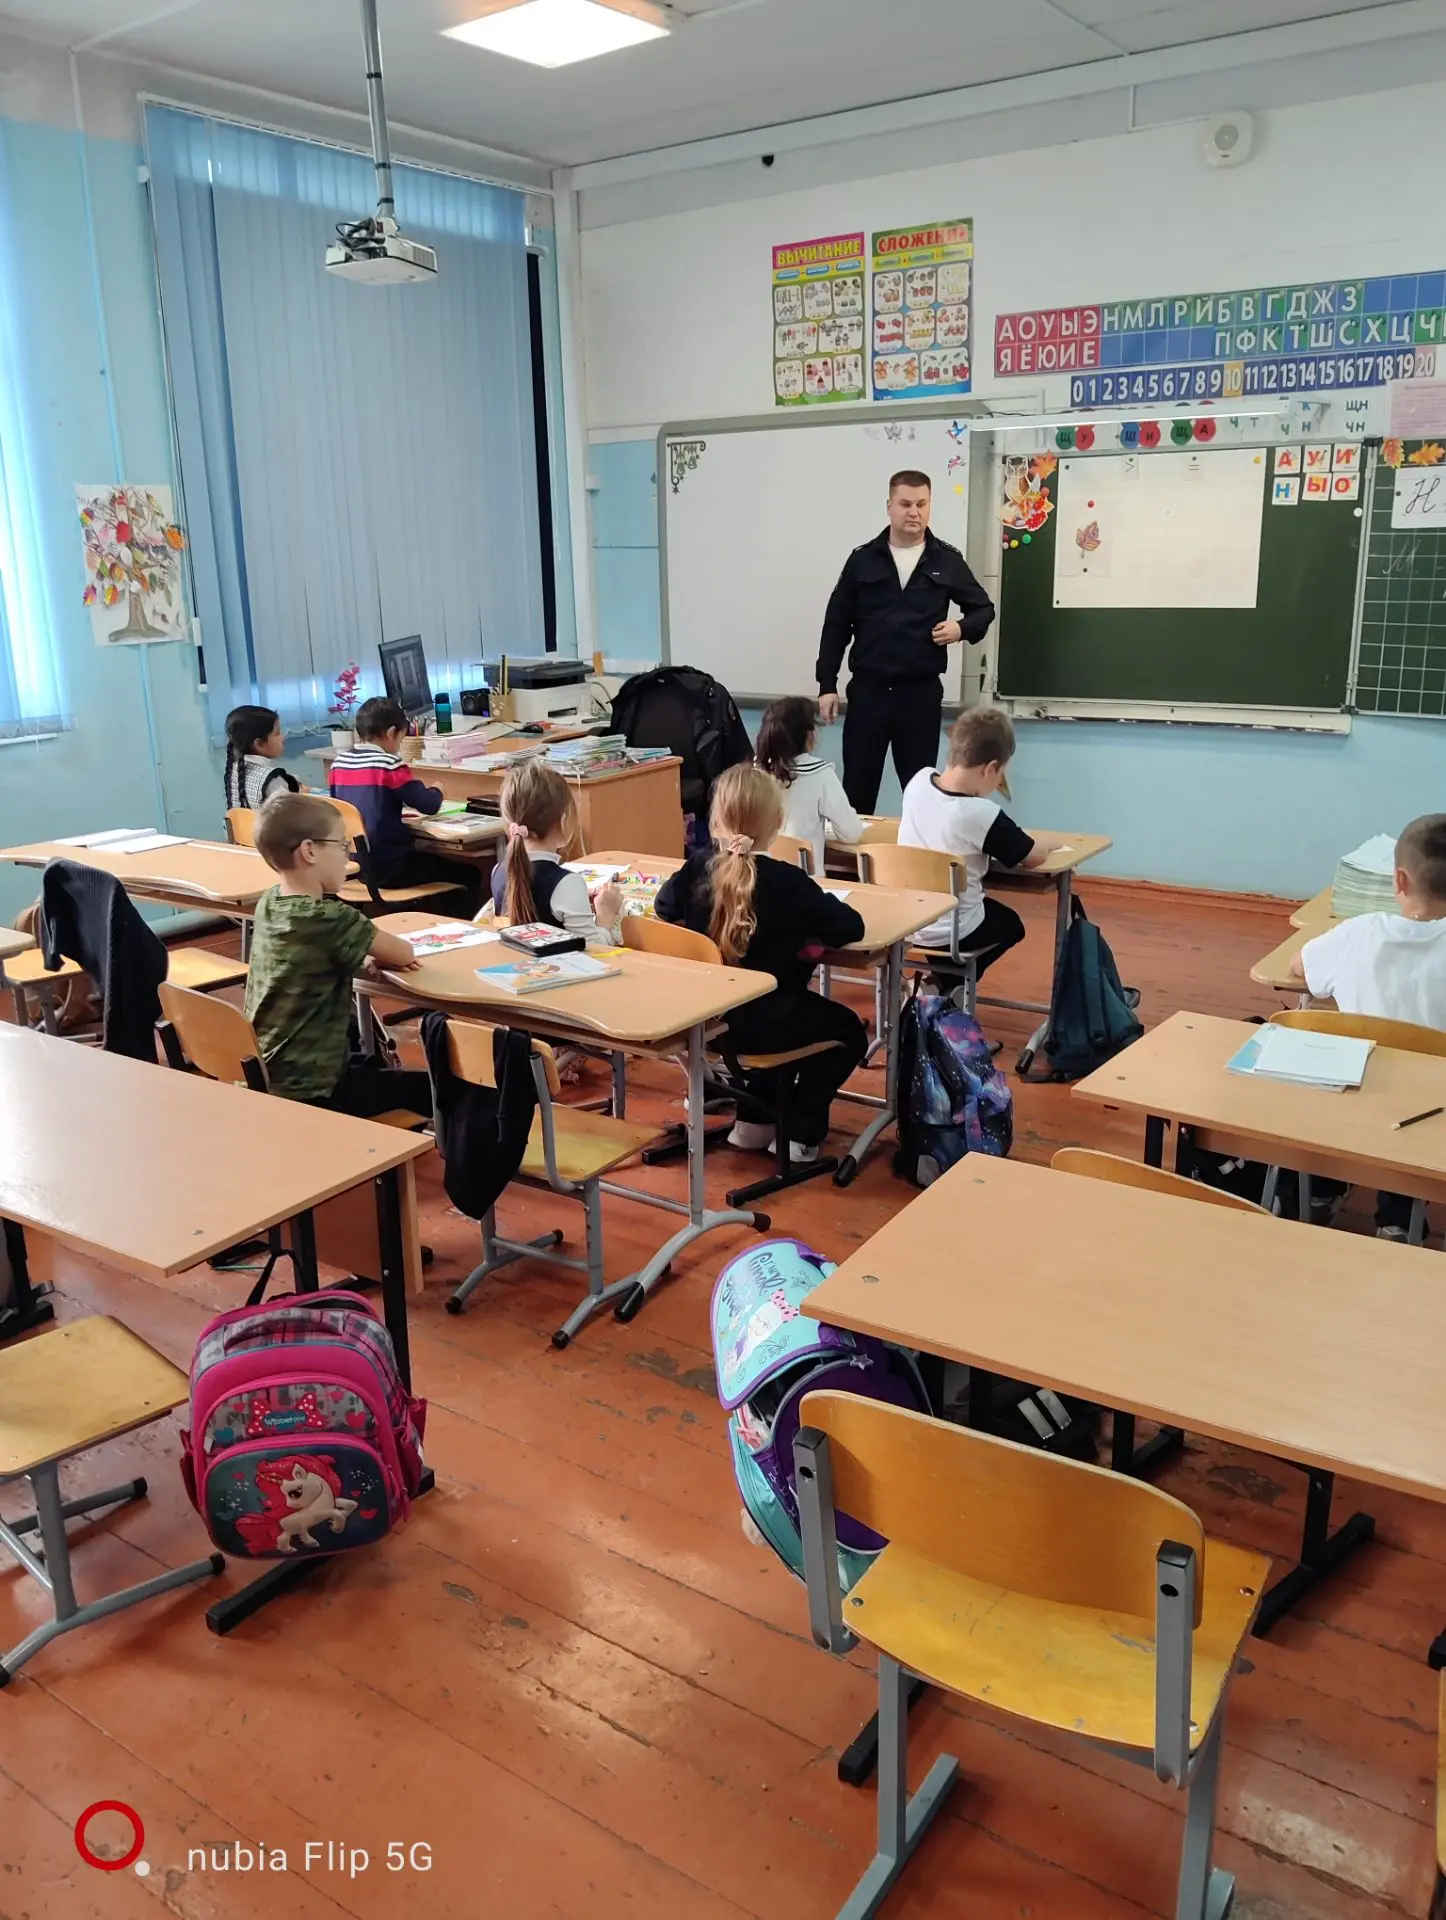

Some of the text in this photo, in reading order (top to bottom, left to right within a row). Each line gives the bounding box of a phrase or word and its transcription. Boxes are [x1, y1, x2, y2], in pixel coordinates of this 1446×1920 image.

[779, 240, 860, 264] ВЫЧИТАНИЕ
[1073, 352, 1434, 403] 0 1 2 3 4 5 6 7 8 9 10 11 12 13 14 15 16 17 18 19 20
[1346, 400, 1368, 413] ЩН
